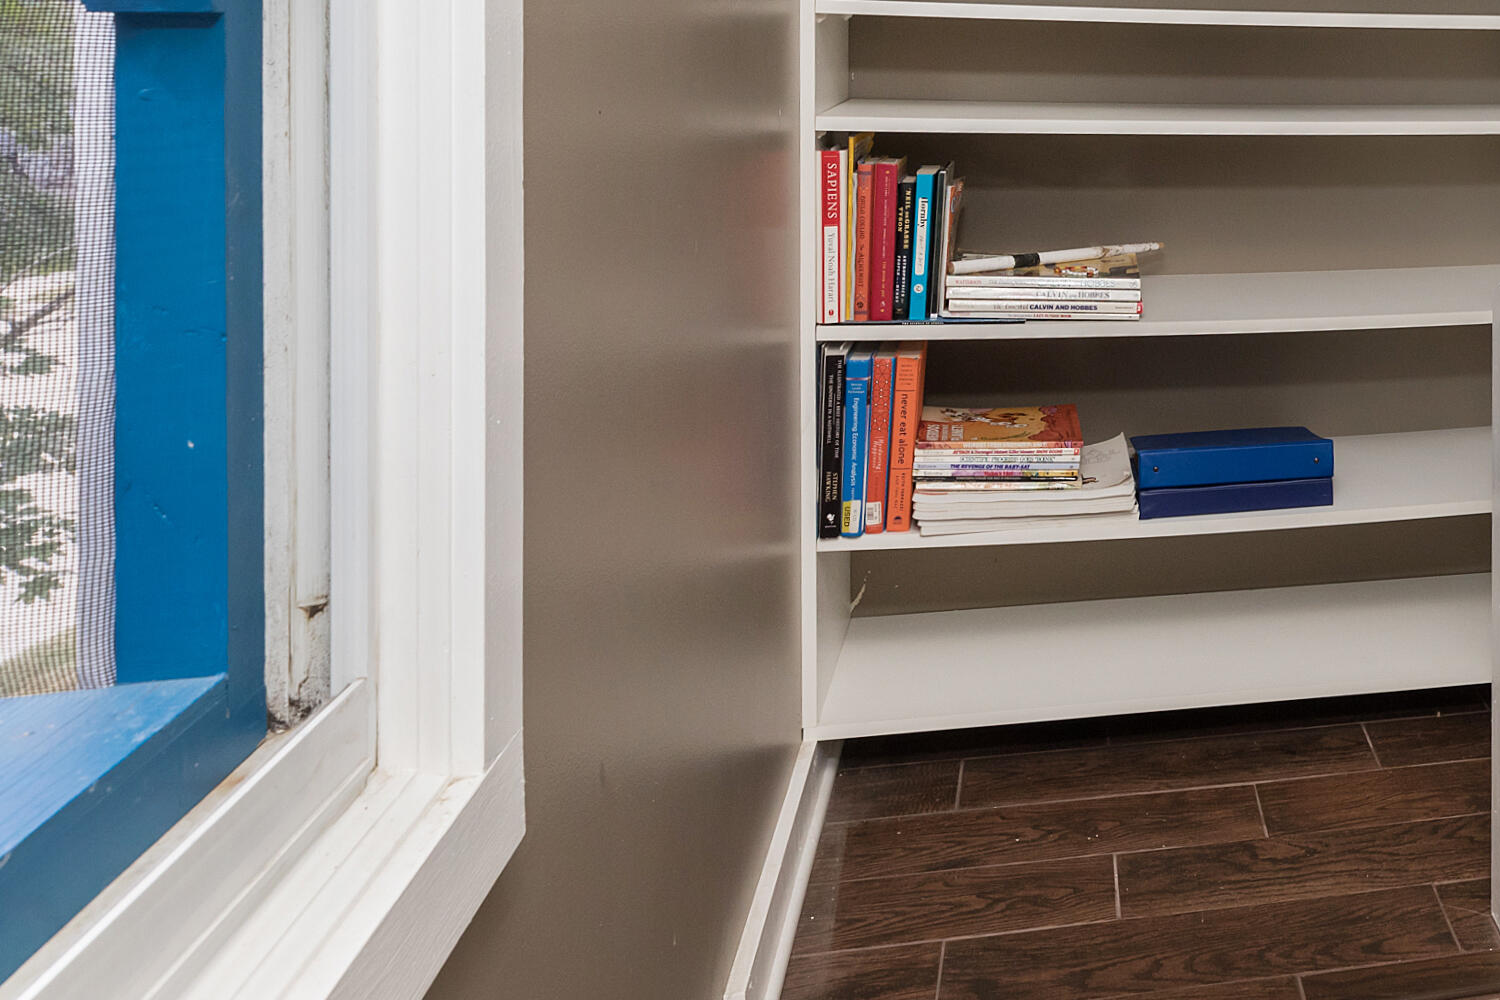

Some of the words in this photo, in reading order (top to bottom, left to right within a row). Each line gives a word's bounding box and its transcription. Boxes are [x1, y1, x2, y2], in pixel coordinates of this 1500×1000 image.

[827, 162, 838, 219] SAPIENS
[918, 197, 929, 230] Hornby
[828, 233, 836, 253] Yuval
[828, 256, 836, 276] Noah
[828, 278, 836, 303] Harari
[851, 398, 860, 433] Engineering
[900, 394, 909, 419] never
[899, 422, 908, 436] eat
[851, 433, 859, 460] Economic
[898, 439, 909, 465] alone
[850, 462, 858, 486] Analysis
